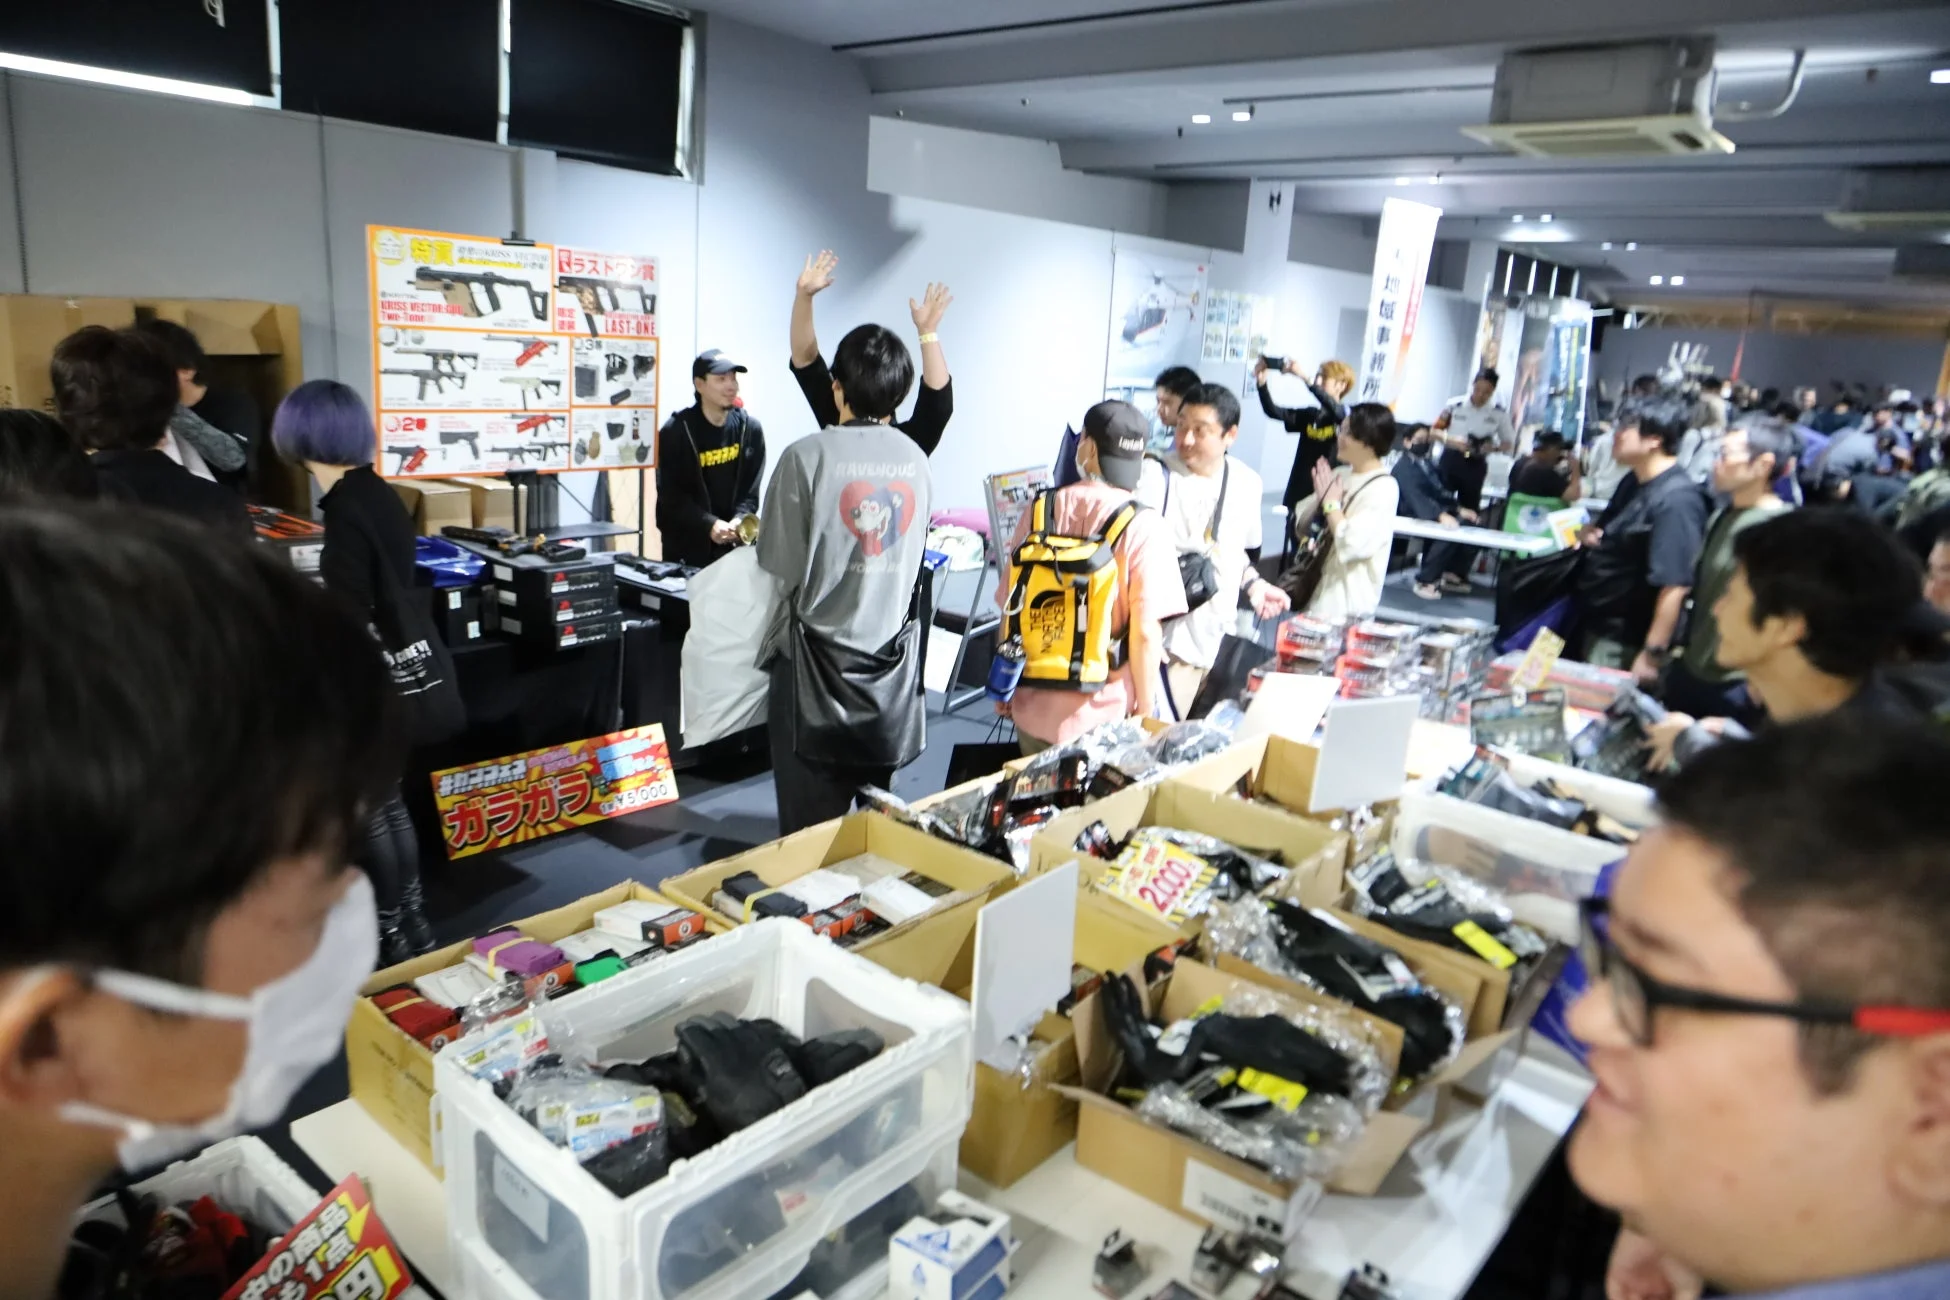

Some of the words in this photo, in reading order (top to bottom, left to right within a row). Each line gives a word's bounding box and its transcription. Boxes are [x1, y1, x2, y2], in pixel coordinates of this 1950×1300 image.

[605, 318, 656, 336] LAST-ONE
[445, 771, 592, 848] ガラガラ
